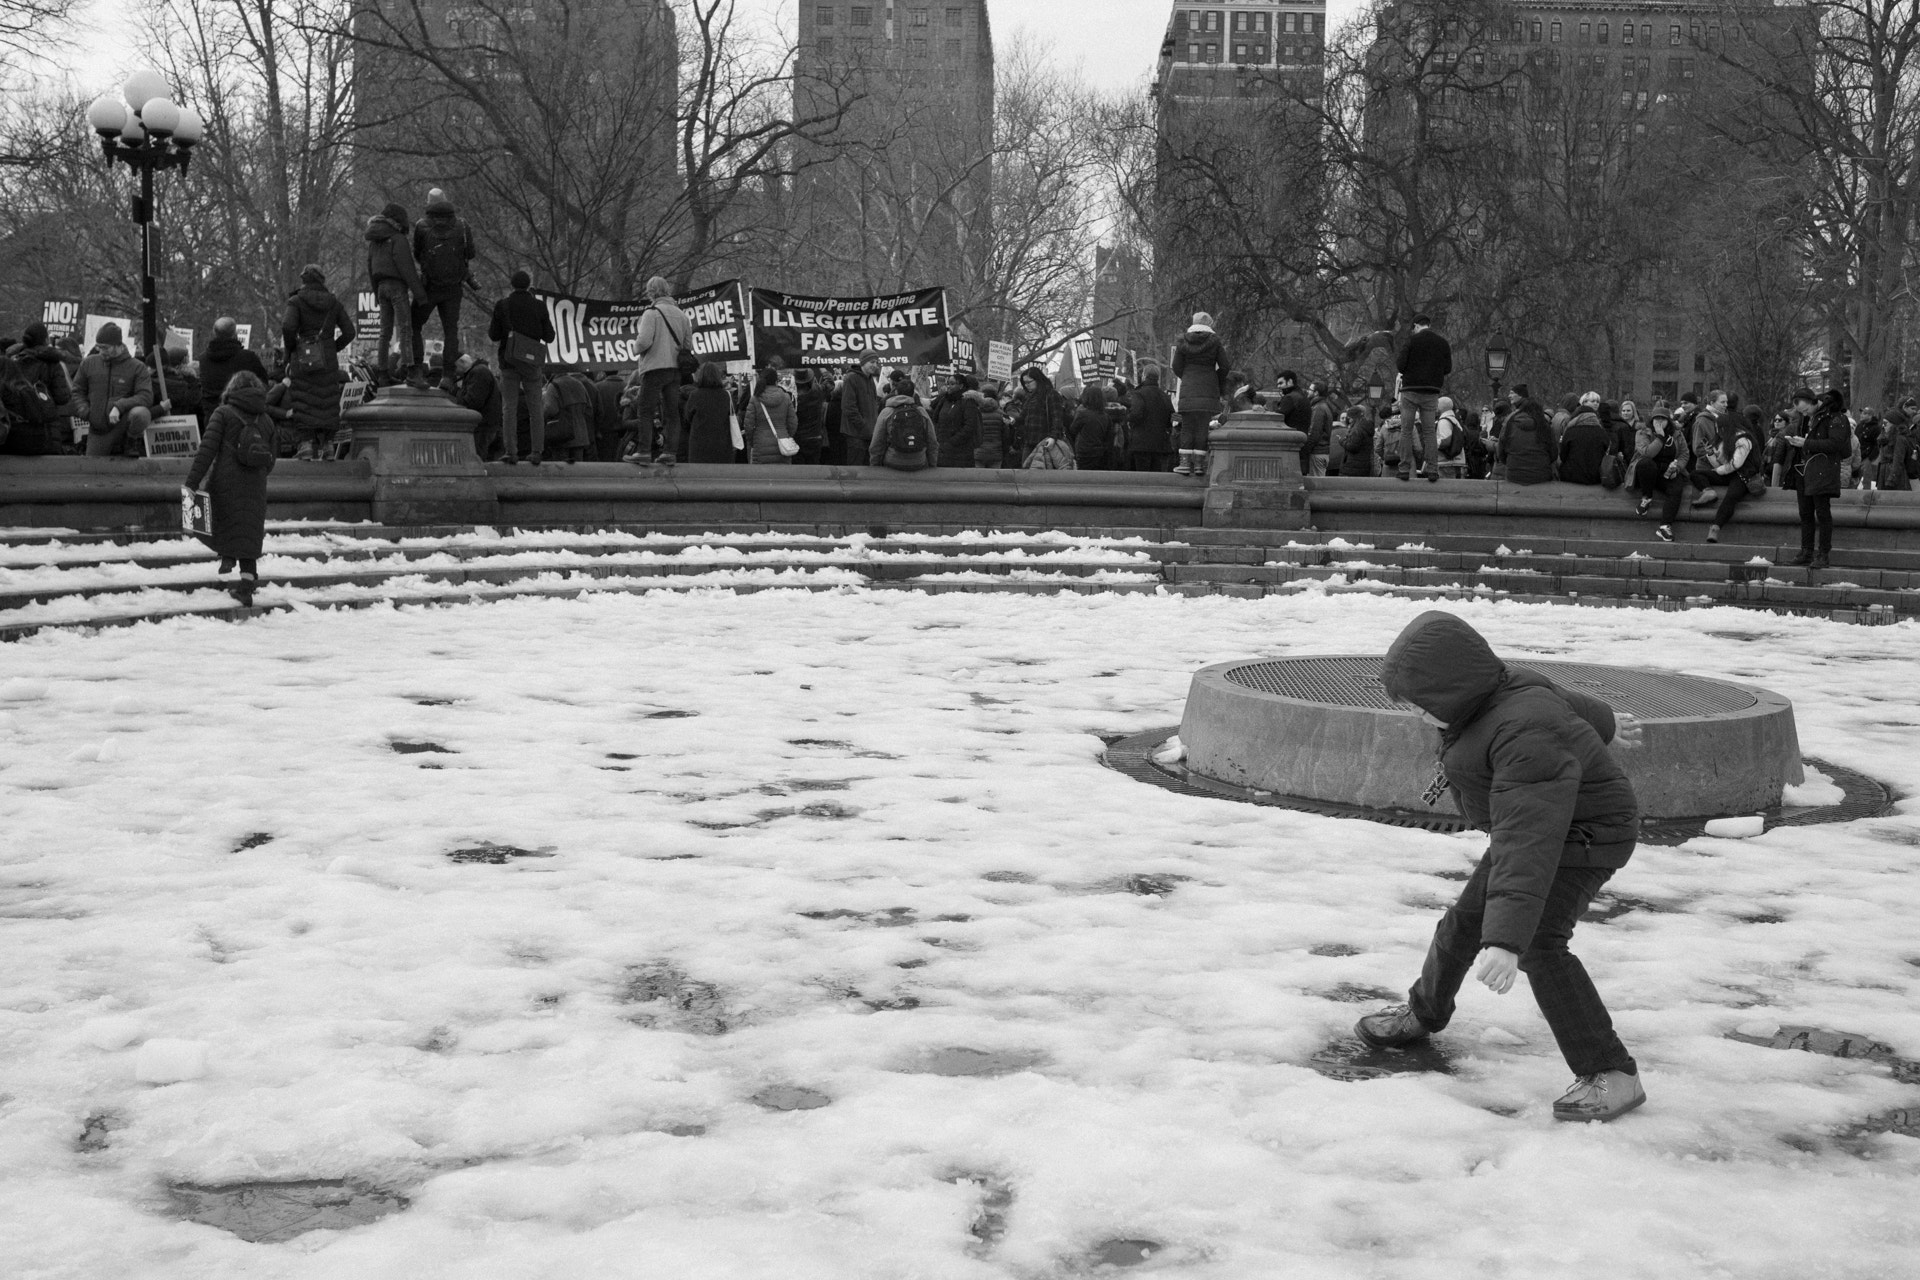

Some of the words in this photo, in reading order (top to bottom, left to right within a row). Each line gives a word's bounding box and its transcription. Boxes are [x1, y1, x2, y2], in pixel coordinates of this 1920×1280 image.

[358, 292, 381, 312] NO
[782, 295, 869, 312] Trump/Pence
[872, 293, 916, 310] Regime
[42, 301, 79, 324] ¡NO!
[763, 307, 939, 330] ILLEGITIMATE
[588, 316, 629, 336] STOP
[592, 339, 640, 363] FASC
[691, 327, 740, 355] GIME
[801, 333, 905, 351] FASCIST
[1077, 341, 1095, 359] NO!
[1100, 339, 1118, 356] NO!
[801, 356, 909, 365] RefuseFasm.org
[154, 430, 190, 442] APOLOGY
[151, 443, 190, 455] WITHOUT
